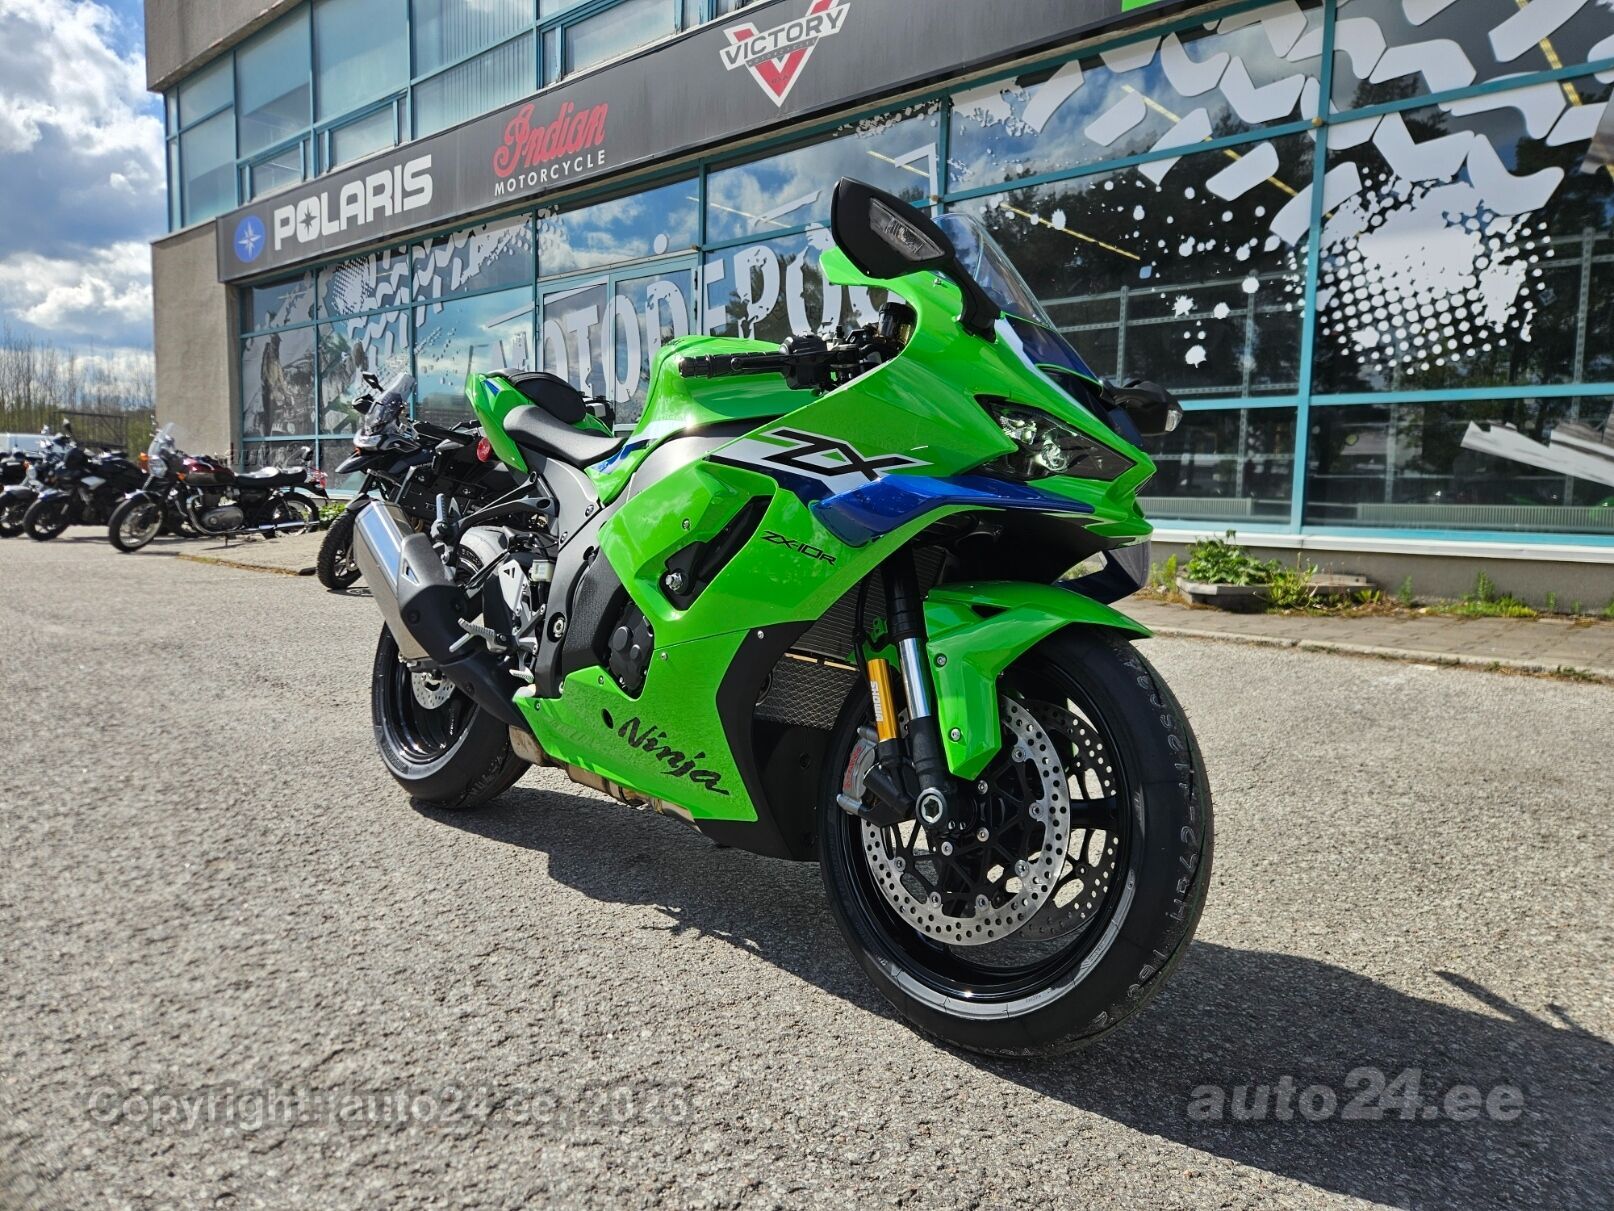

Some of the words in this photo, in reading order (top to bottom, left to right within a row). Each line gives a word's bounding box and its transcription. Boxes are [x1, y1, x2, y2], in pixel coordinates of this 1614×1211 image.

[725, 8, 844, 65] VICTORY
[493, 102, 609, 178] Indian
[494, 150, 605, 197] MOTORCYCLE
[274, 154, 433, 251] POLARIS
[761, 429, 918, 482] ZX
[760, 530, 837, 566] ZX-10R
[870, 681, 884, 722] SHOWA
[618, 716, 730, 796] Ninja
